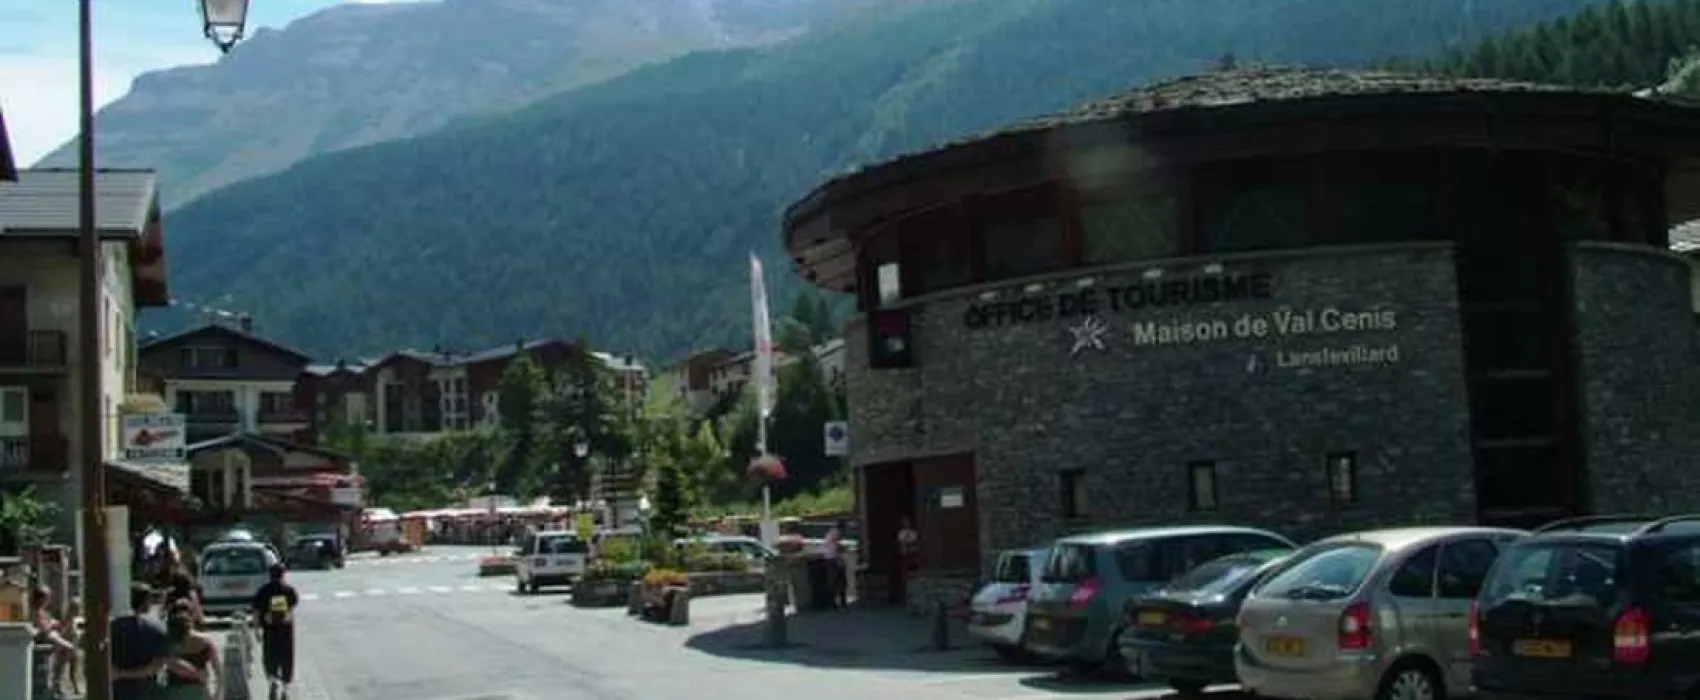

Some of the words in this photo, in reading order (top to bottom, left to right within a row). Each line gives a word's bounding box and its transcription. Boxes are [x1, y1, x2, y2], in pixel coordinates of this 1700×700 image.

[964, 299, 1053, 328] OFFICE
[1059, 290, 1098, 316] DE
[1109, 274, 1273, 310] TOURISME
[1132, 319, 1228, 346] Maison
[1233, 314, 1269, 338] de
[1272, 310, 1313, 334] Val
[1321, 306, 1397, 332] Cenis
